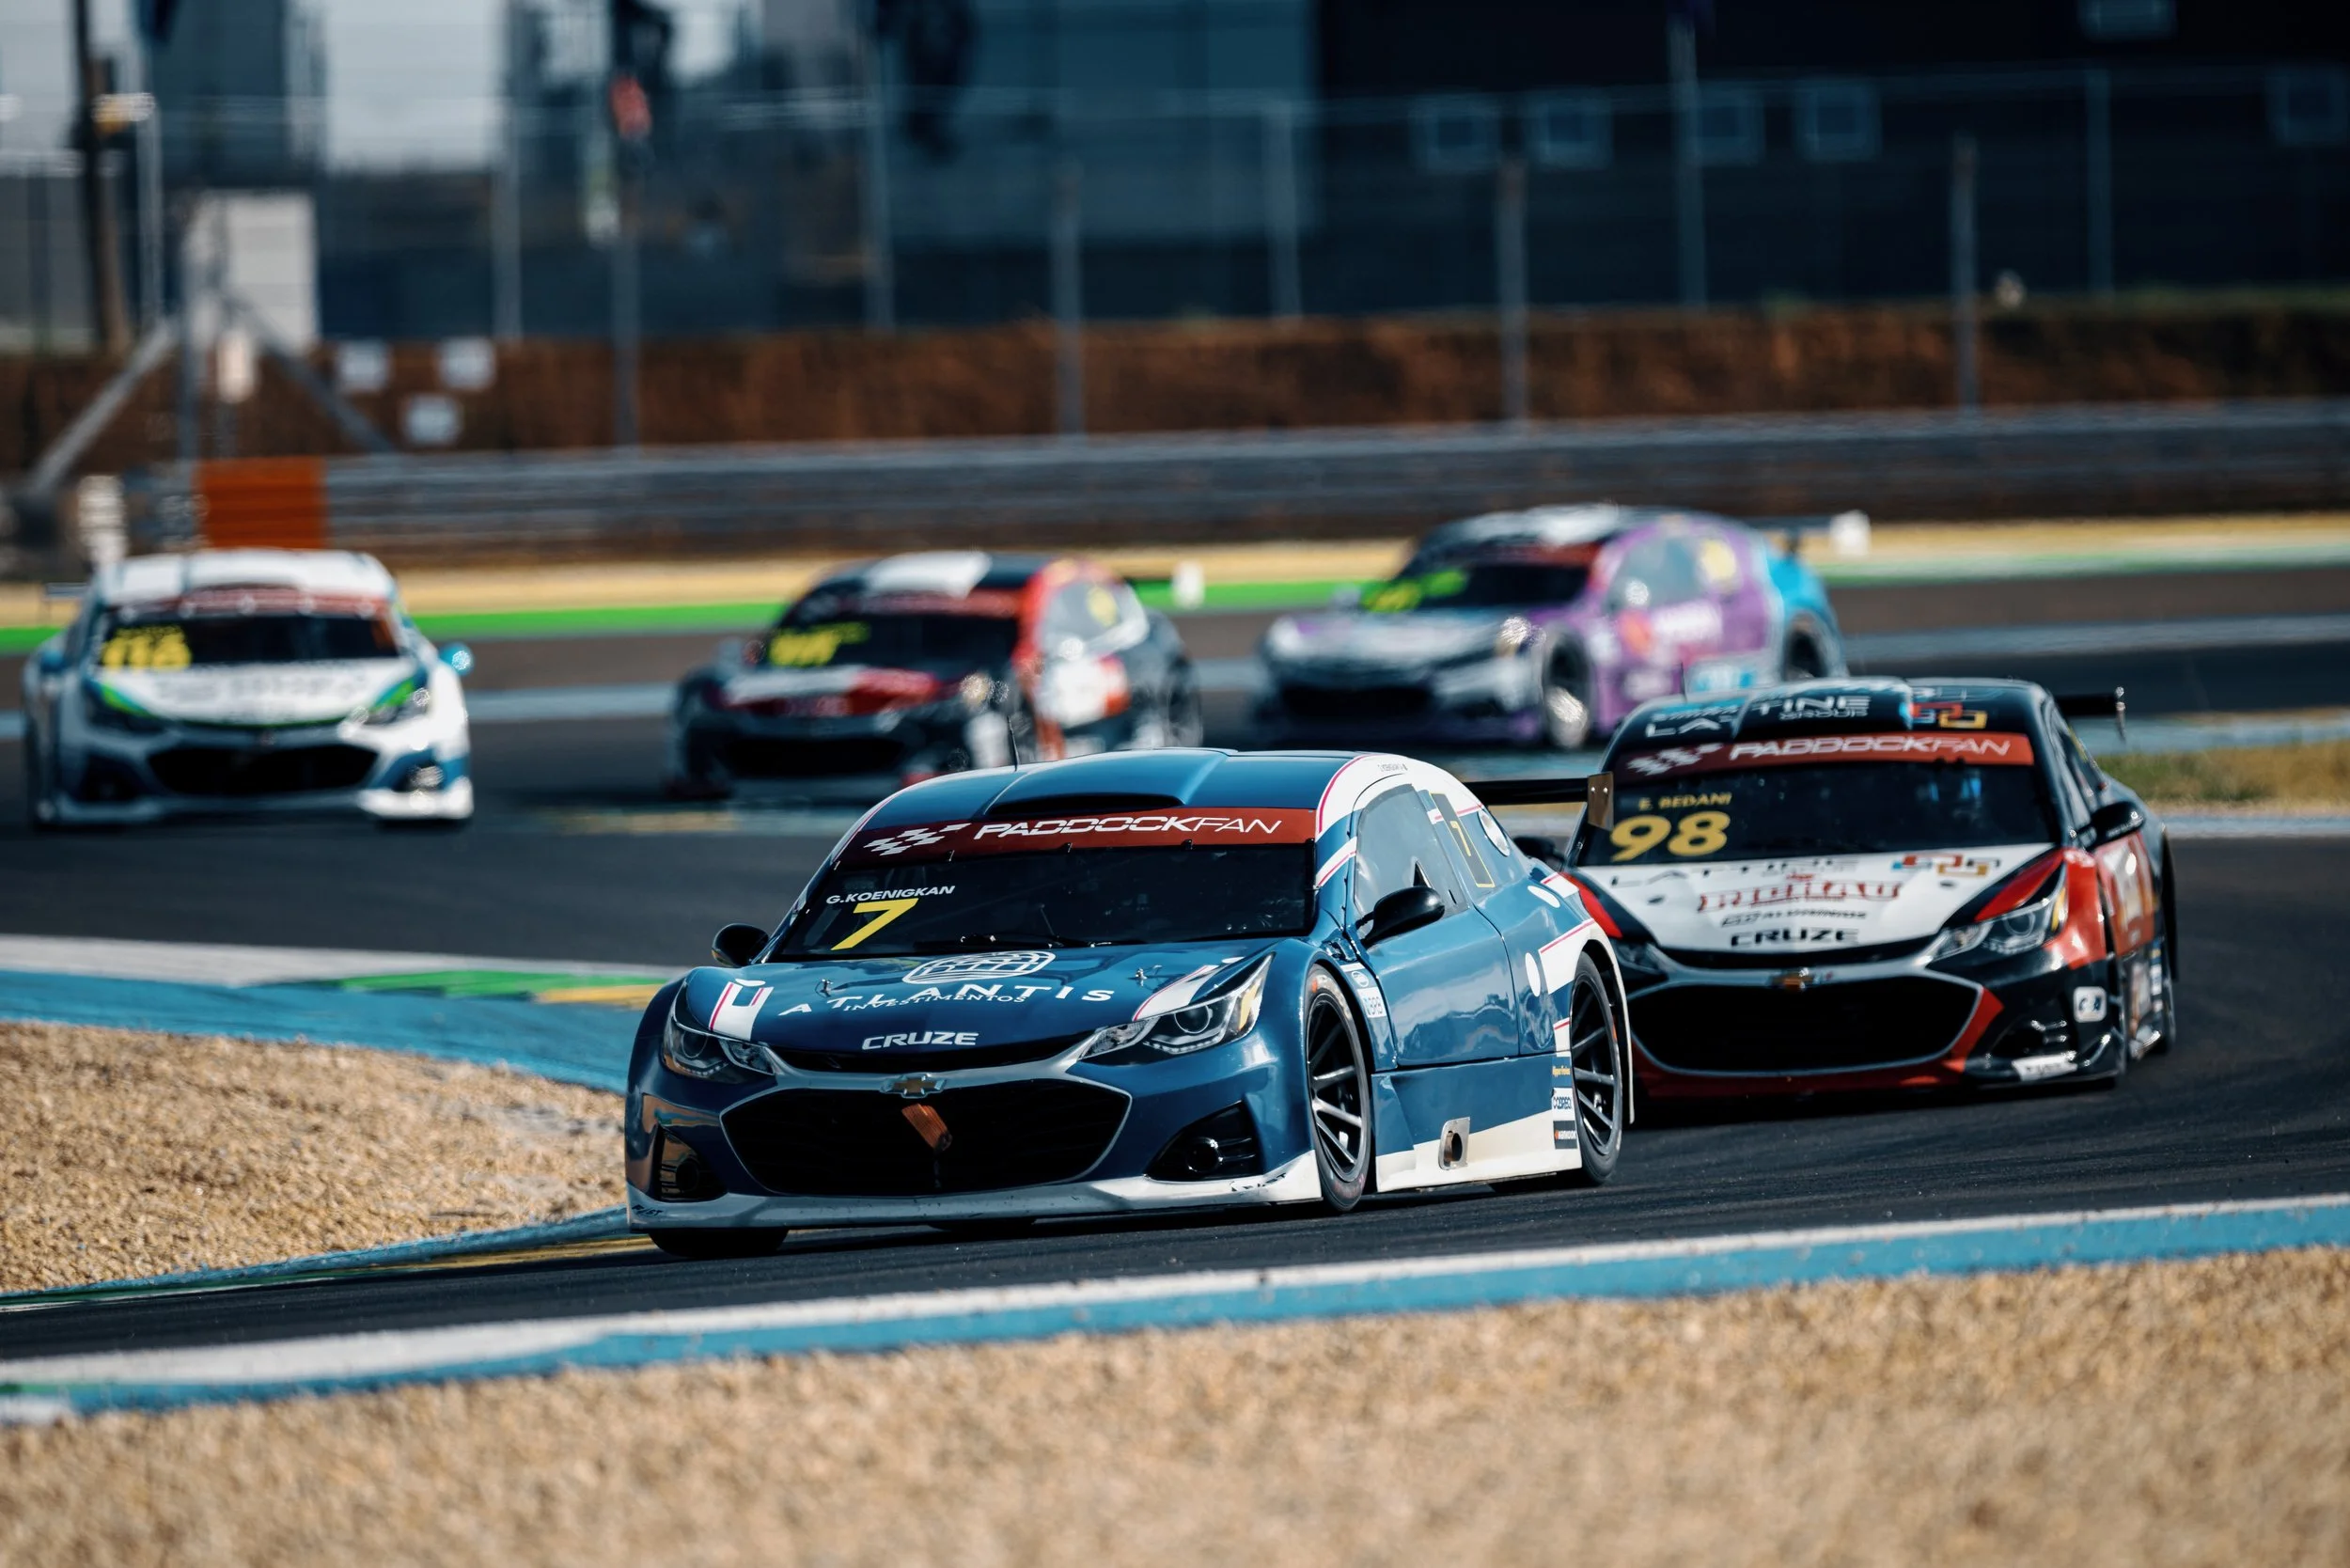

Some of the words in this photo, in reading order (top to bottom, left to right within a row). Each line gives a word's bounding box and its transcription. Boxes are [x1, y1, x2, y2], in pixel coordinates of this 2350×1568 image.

[1730, 735, 2011, 760] PADDOCKFAN
[1658, 792, 1733, 809] BEDANI
[973, 815, 1283, 840] PADDOCKFAN
[1609, 810, 1731, 862] 98
[825, 885, 956, 904] G.KOENIGKAN
[830, 898, 919, 951] 7
[1731, 926, 1859, 948] CRUZE
[777, 983, 1115, 1016] ATLANTIS
[842, 994, 1027, 1011] INVESTIMENTOS
[862, 1031, 979, 1051] CRUZE
